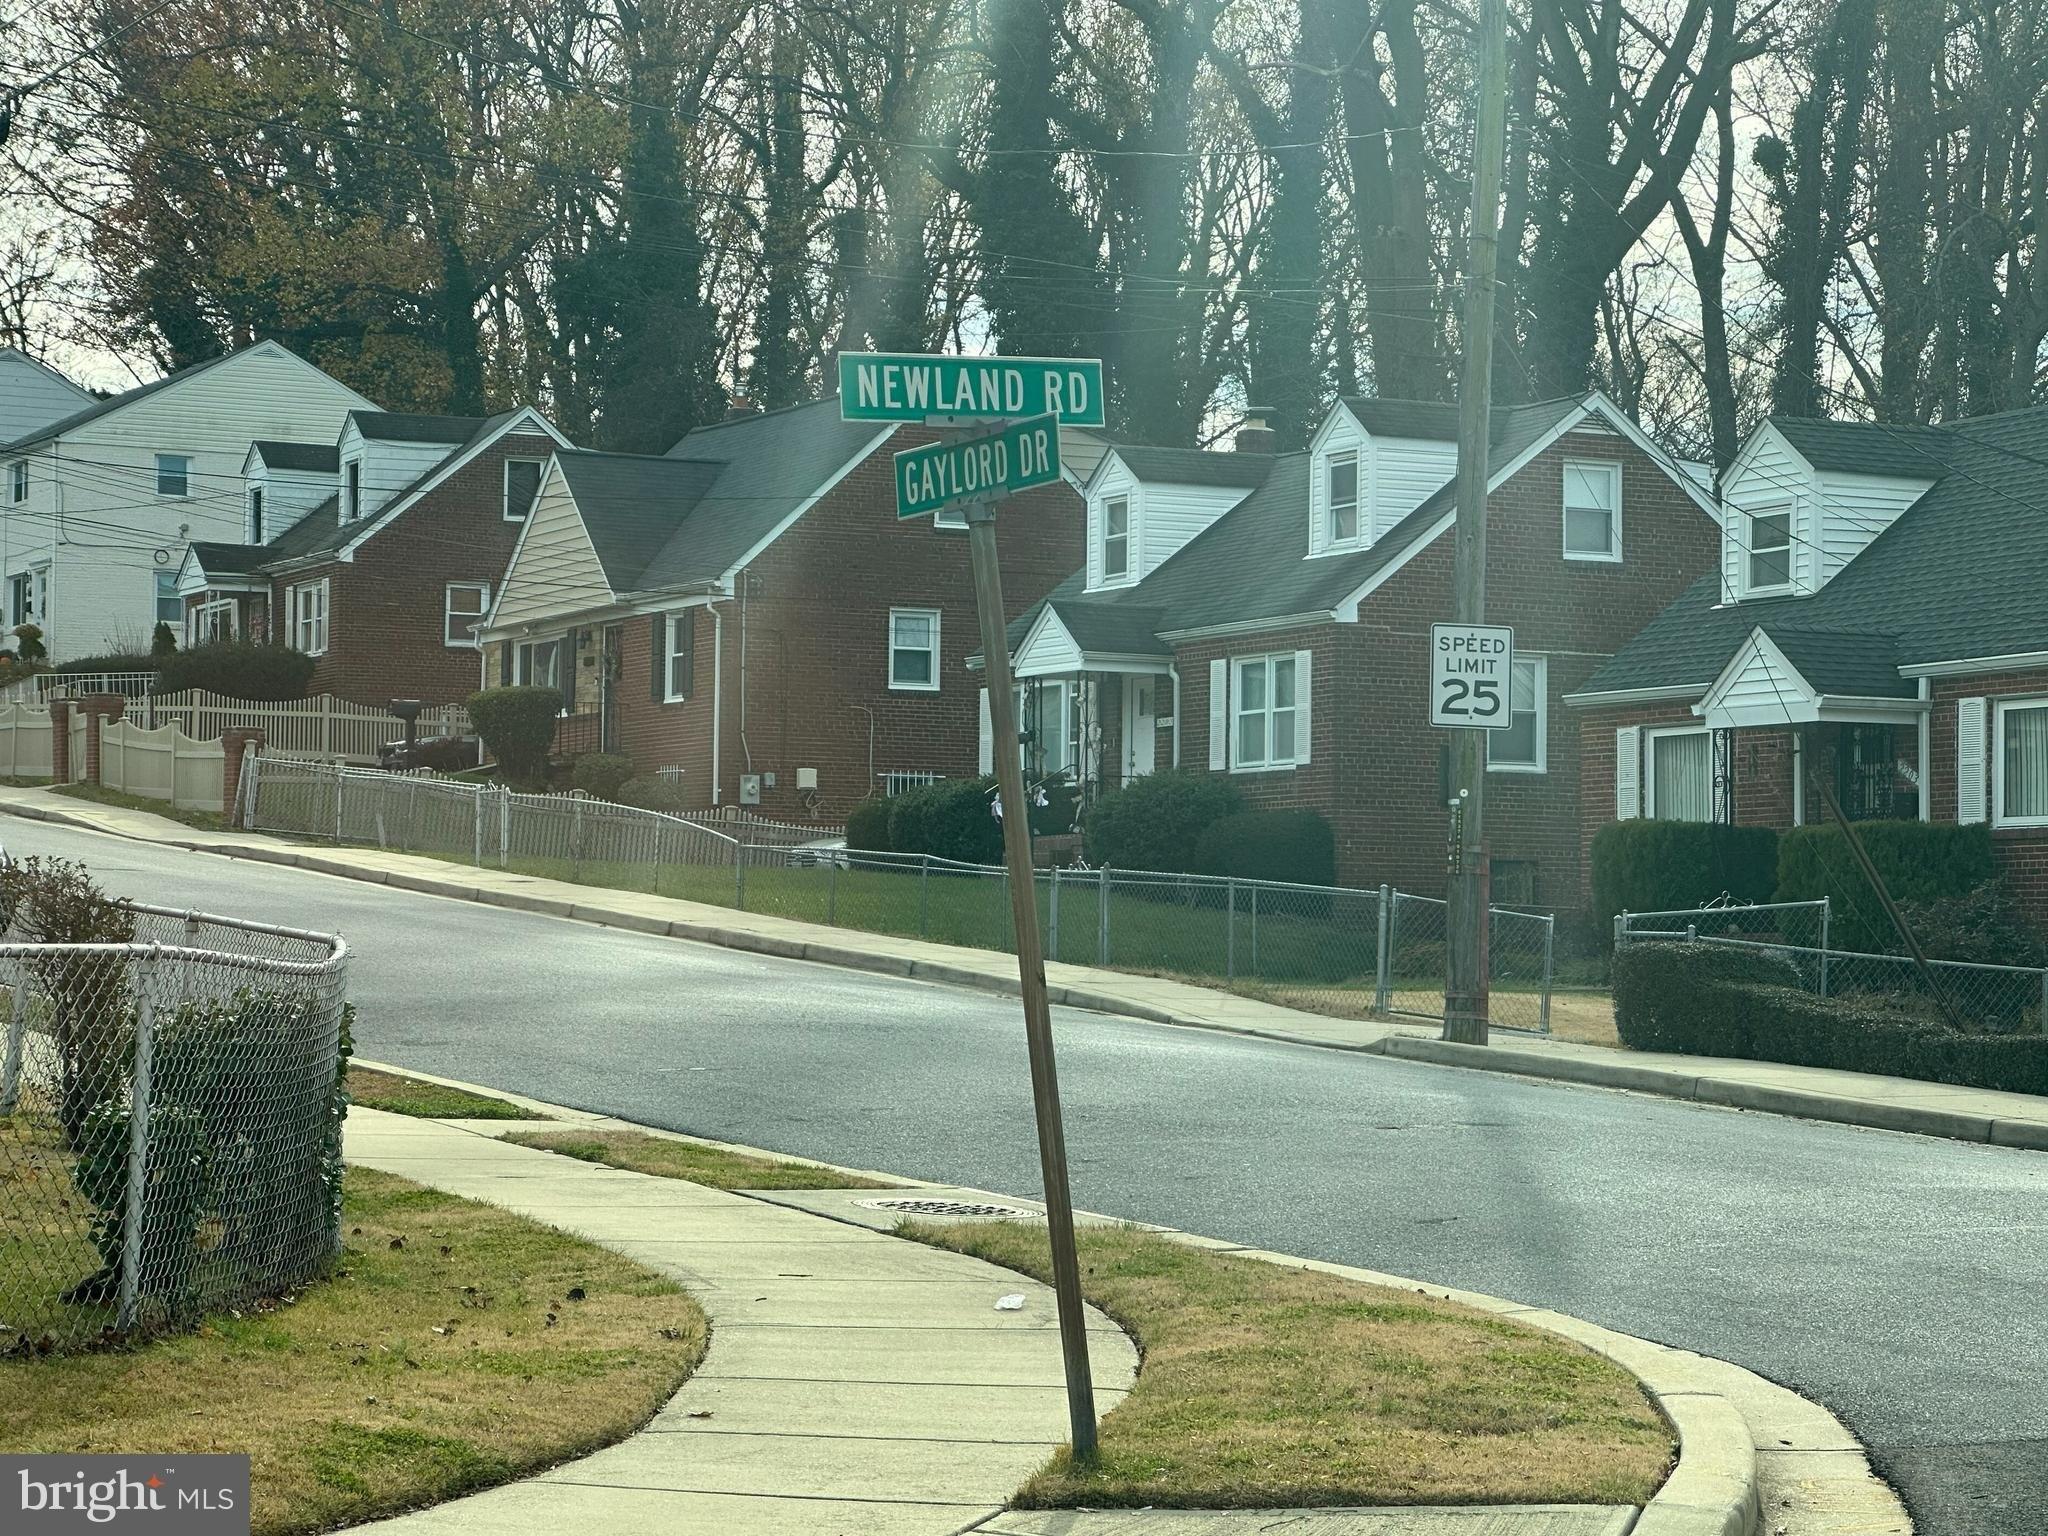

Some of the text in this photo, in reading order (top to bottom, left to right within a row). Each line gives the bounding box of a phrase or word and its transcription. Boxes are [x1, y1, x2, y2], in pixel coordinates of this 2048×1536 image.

[857, 364, 1088, 414] NEWLAND RD
[905, 429, 1049, 505] GAYLORD DR
[1438, 636, 1505, 654] SPEED
[1446, 657, 1497, 674] LIMIT
[1441, 678, 1501, 716] 25
